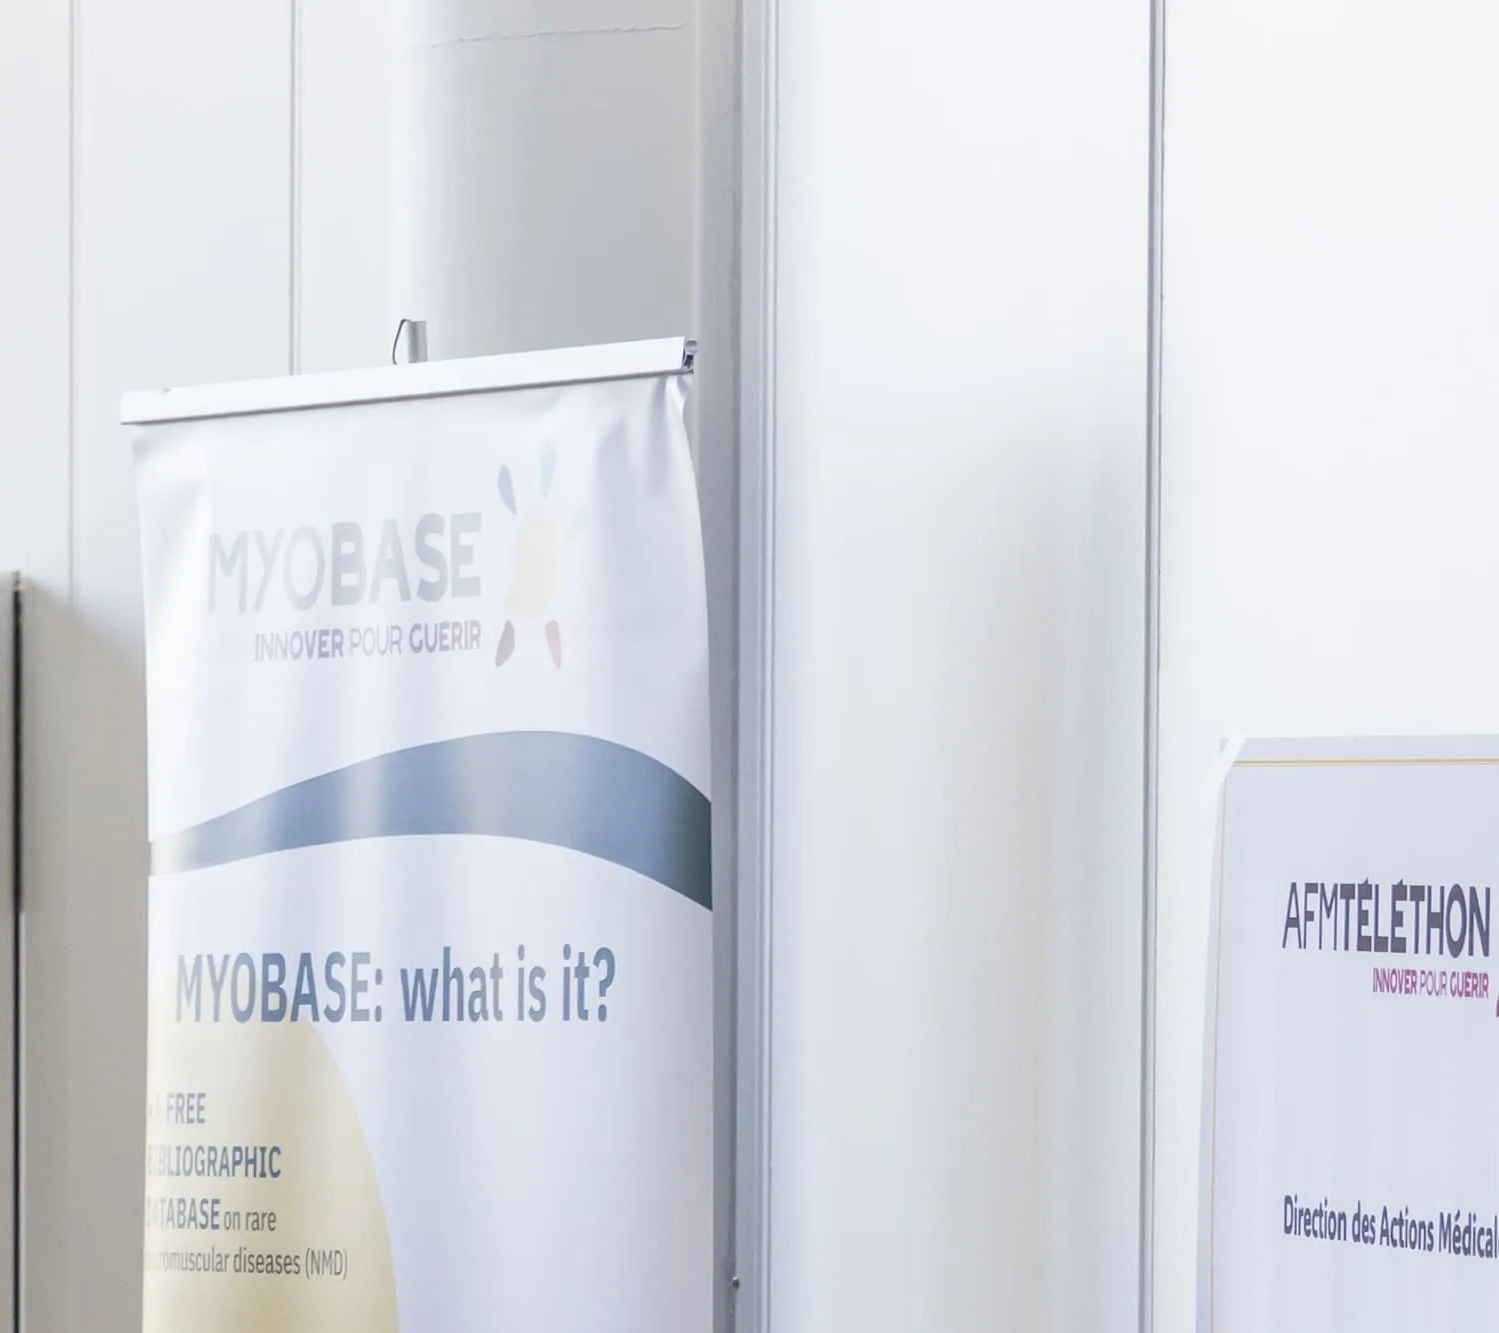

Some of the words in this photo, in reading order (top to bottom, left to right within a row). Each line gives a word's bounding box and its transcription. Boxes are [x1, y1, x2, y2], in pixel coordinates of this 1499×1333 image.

[207, 513, 483, 615] MYOBASE
[253, 627, 344, 662] INNOVER
[349, 626, 402, 656] POUR
[175, 950, 384, 1025] MYOBASE:
[401, 946, 503, 1024] what
[517, 945, 546, 1023] is
[560, 944, 617, 1023] it?
[1372, 967, 1418, 995] INNOVER
[1419, 970, 1448, 997] POUR
[166, 1093, 207, 1124] FREE
[223, 1211, 241, 1231] on
[245, 1210, 276, 1231] rare
[1283, 1194, 1348, 1242] Direction
[1352, 1200, 1376, 1245] des
[1379, 1204, 1434, 1253] Actions
[1439, 1208, 1499, 1260] Médical
[233, 1246, 301, 1275] diseases
[305, 1248, 348, 1281] (NMD)
